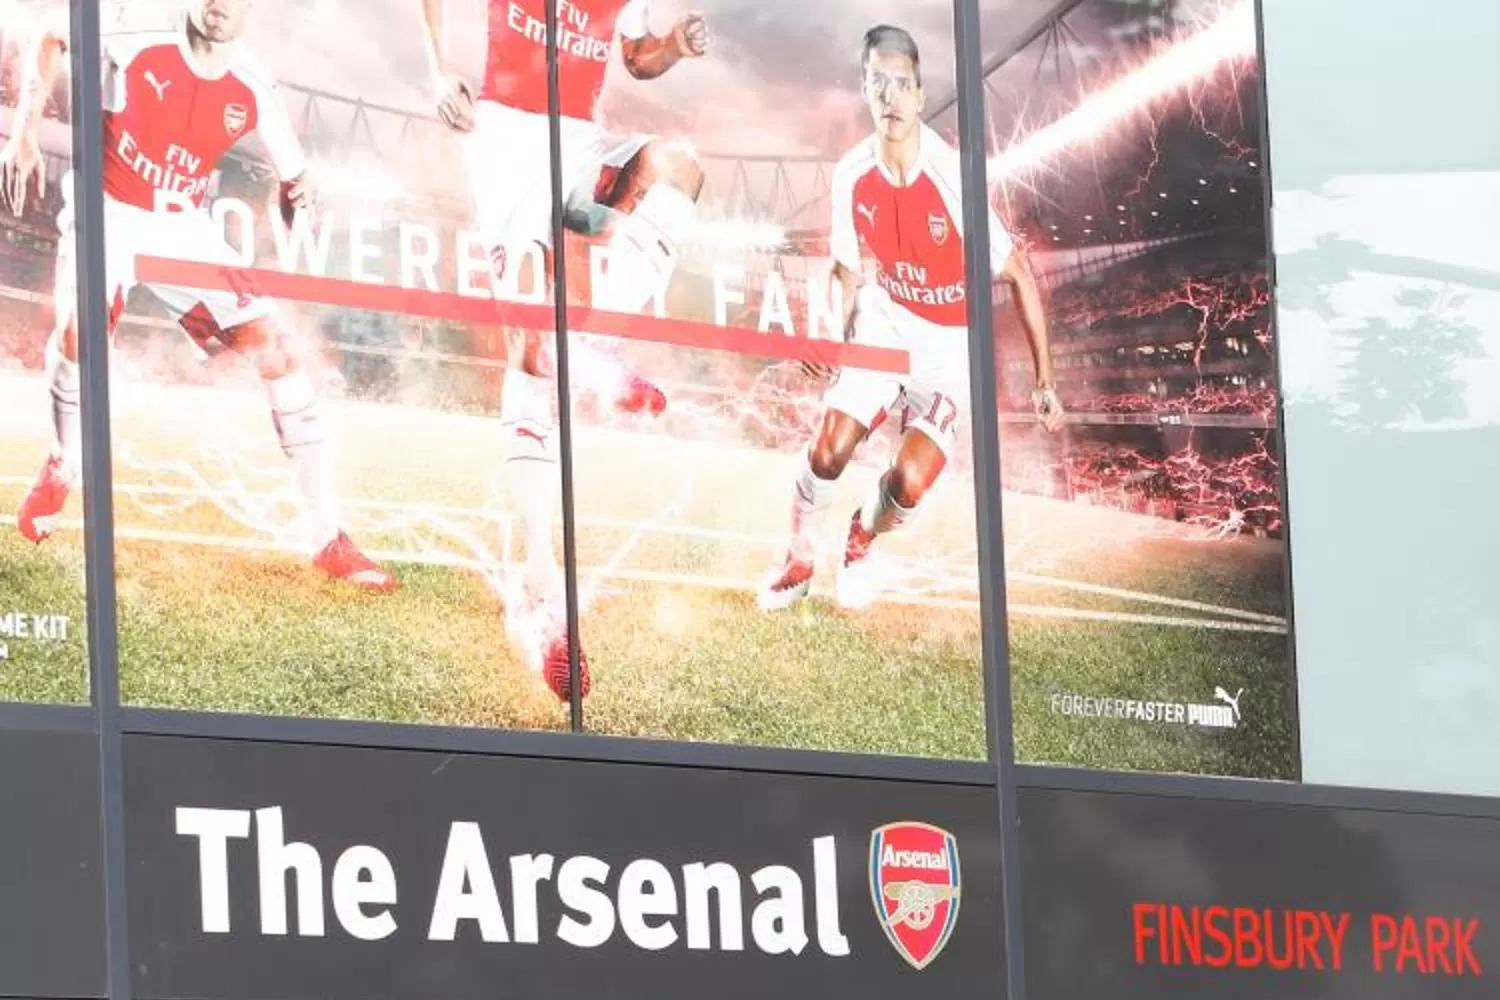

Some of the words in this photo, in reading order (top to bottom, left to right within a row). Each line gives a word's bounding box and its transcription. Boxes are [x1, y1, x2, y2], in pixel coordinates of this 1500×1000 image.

[117, 129, 213, 196] Emirat
[165, 144, 200, 174] Fly
[880, 272, 965, 305] mirates
[895, 261, 927, 286] Fly
[33, 613, 71, 640] KIT
[882, 844, 948, 869] Arsenal
[175, 805, 398, 940] The
[428, 820, 850, 957] Arsenal
[1132, 902, 1351, 971] FINSBURY
[1372, 912, 1483, 976] PARK
